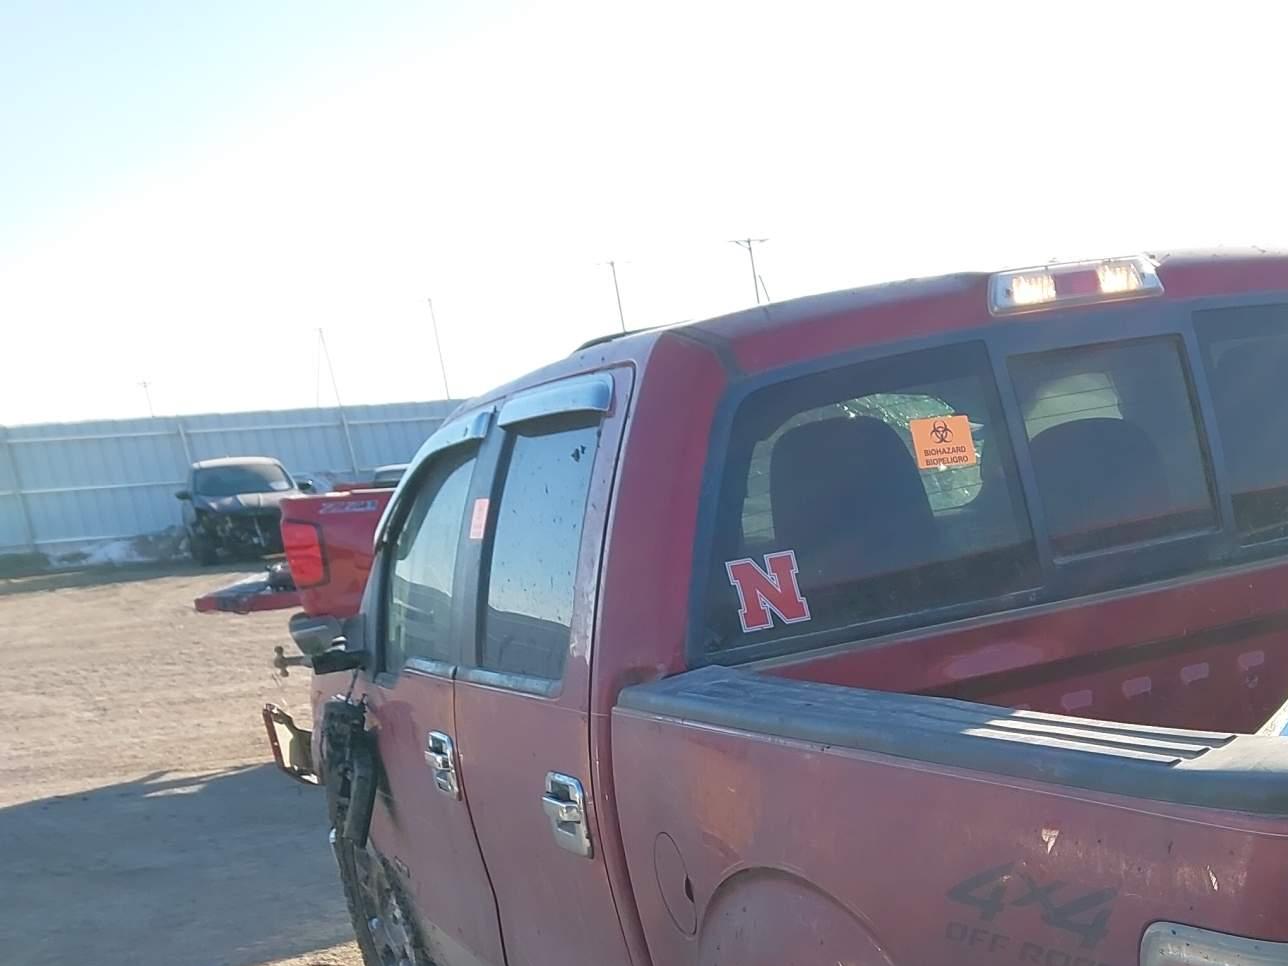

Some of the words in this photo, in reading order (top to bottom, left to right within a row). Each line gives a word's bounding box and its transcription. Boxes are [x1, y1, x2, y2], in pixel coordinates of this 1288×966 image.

[923, 445, 967, 457] BIOHAZARD
[925, 455, 969, 466] BIOPELIGRO
[725, 550, 811, 633] N
[944, 920, 1010, 953] OFF
